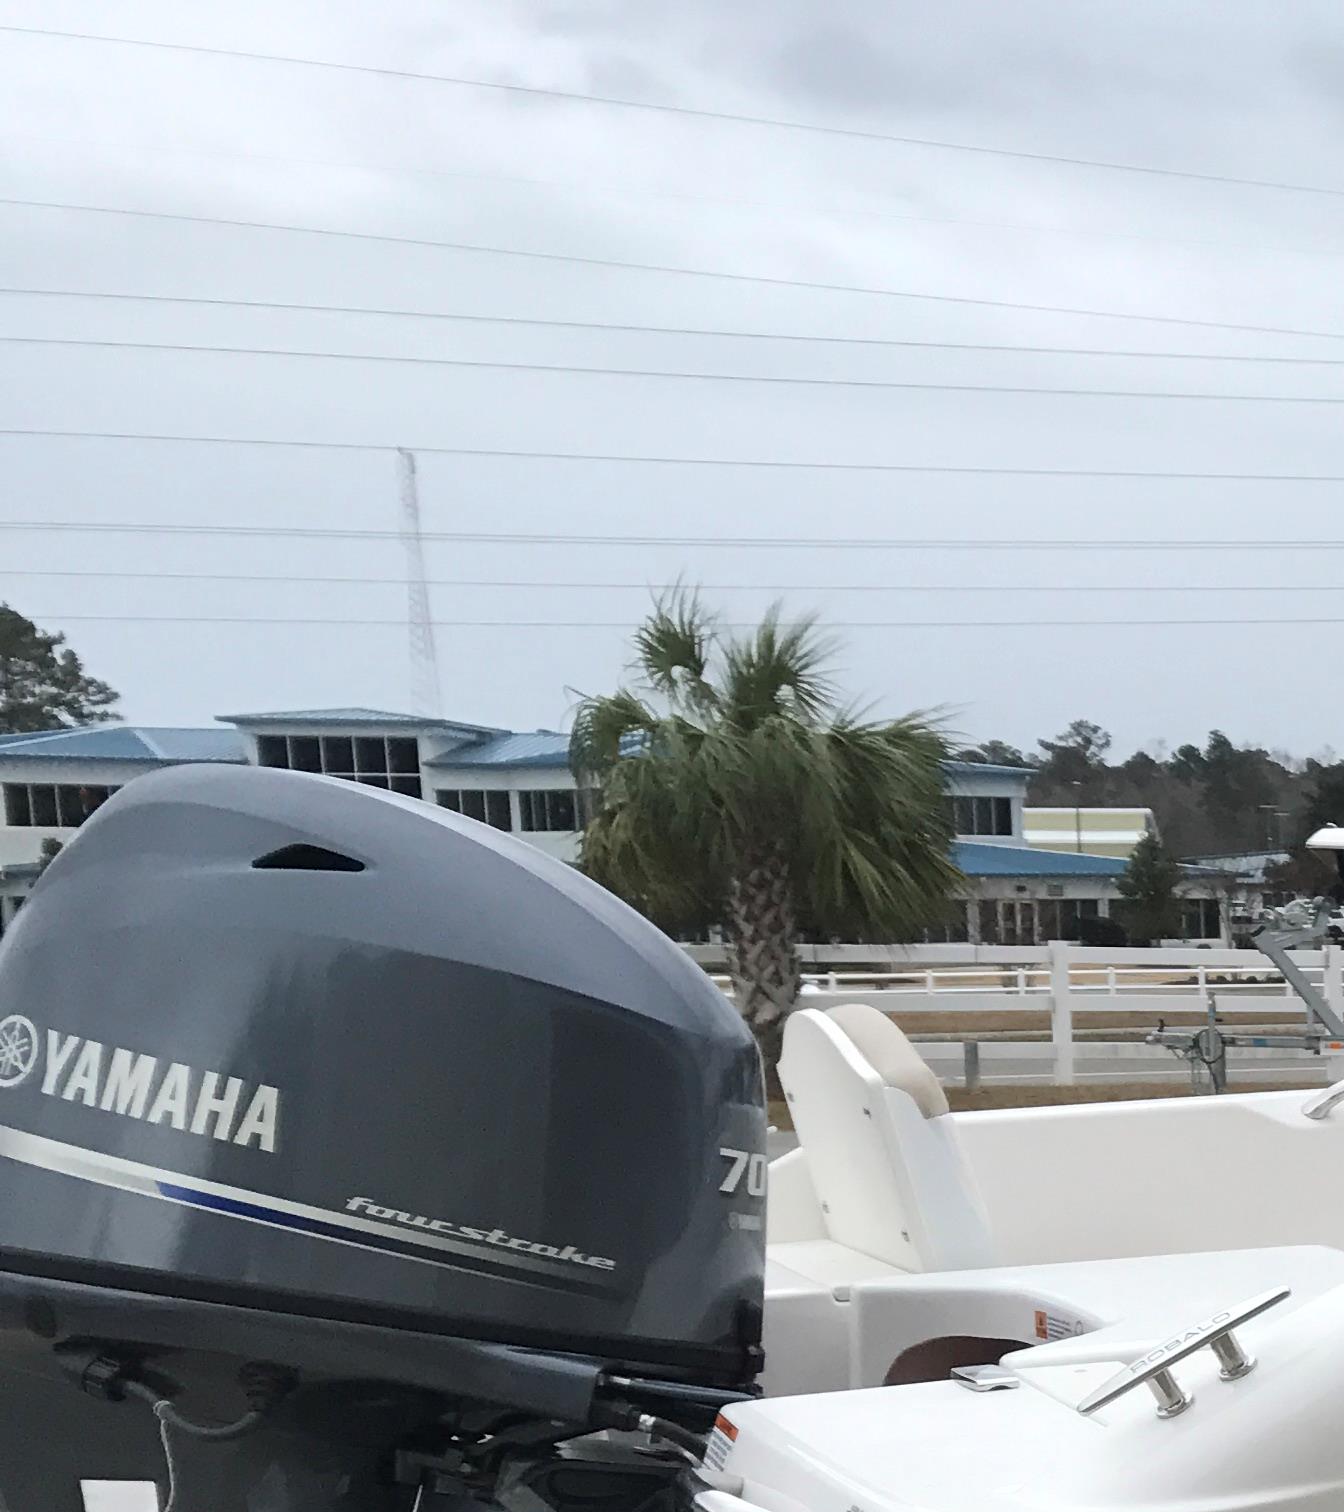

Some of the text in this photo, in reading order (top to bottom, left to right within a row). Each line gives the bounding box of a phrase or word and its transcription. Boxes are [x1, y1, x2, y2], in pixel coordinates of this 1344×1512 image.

[42, 1029, 281, 1153] YAMAHA
[719, 1147, 768, 1196] 70
[1130, 1312, 1231, 1373] ROBALO
